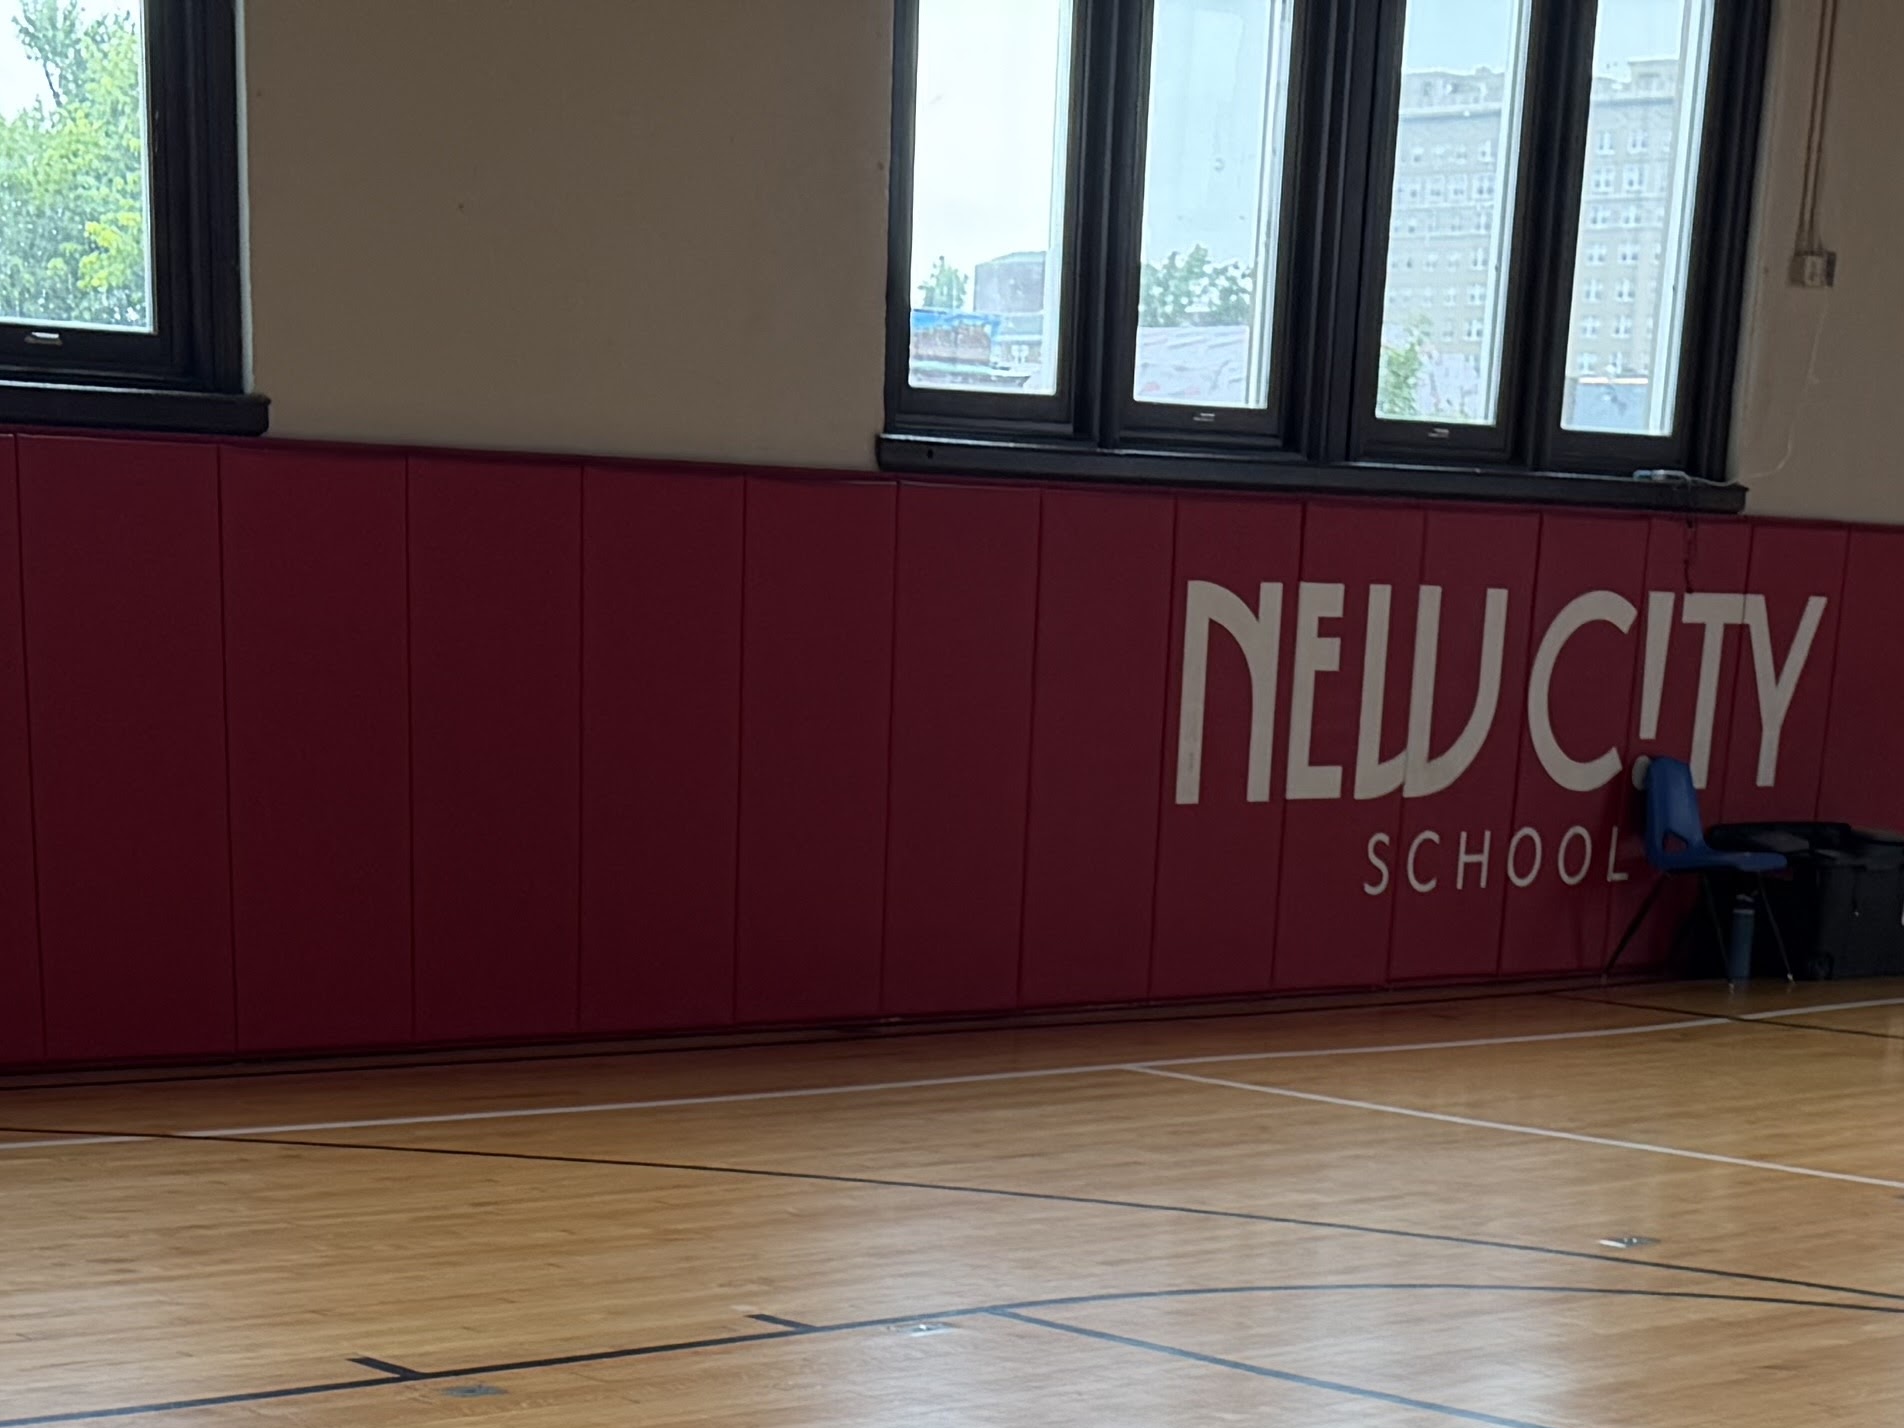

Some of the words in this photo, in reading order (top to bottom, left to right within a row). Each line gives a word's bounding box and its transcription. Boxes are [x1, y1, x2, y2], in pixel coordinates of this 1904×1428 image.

[1175, 580, 1509, 804] NEW
[1527, 590, 1828, 792] CITY
[1363, 825, 1629, 896] SCHOOL
